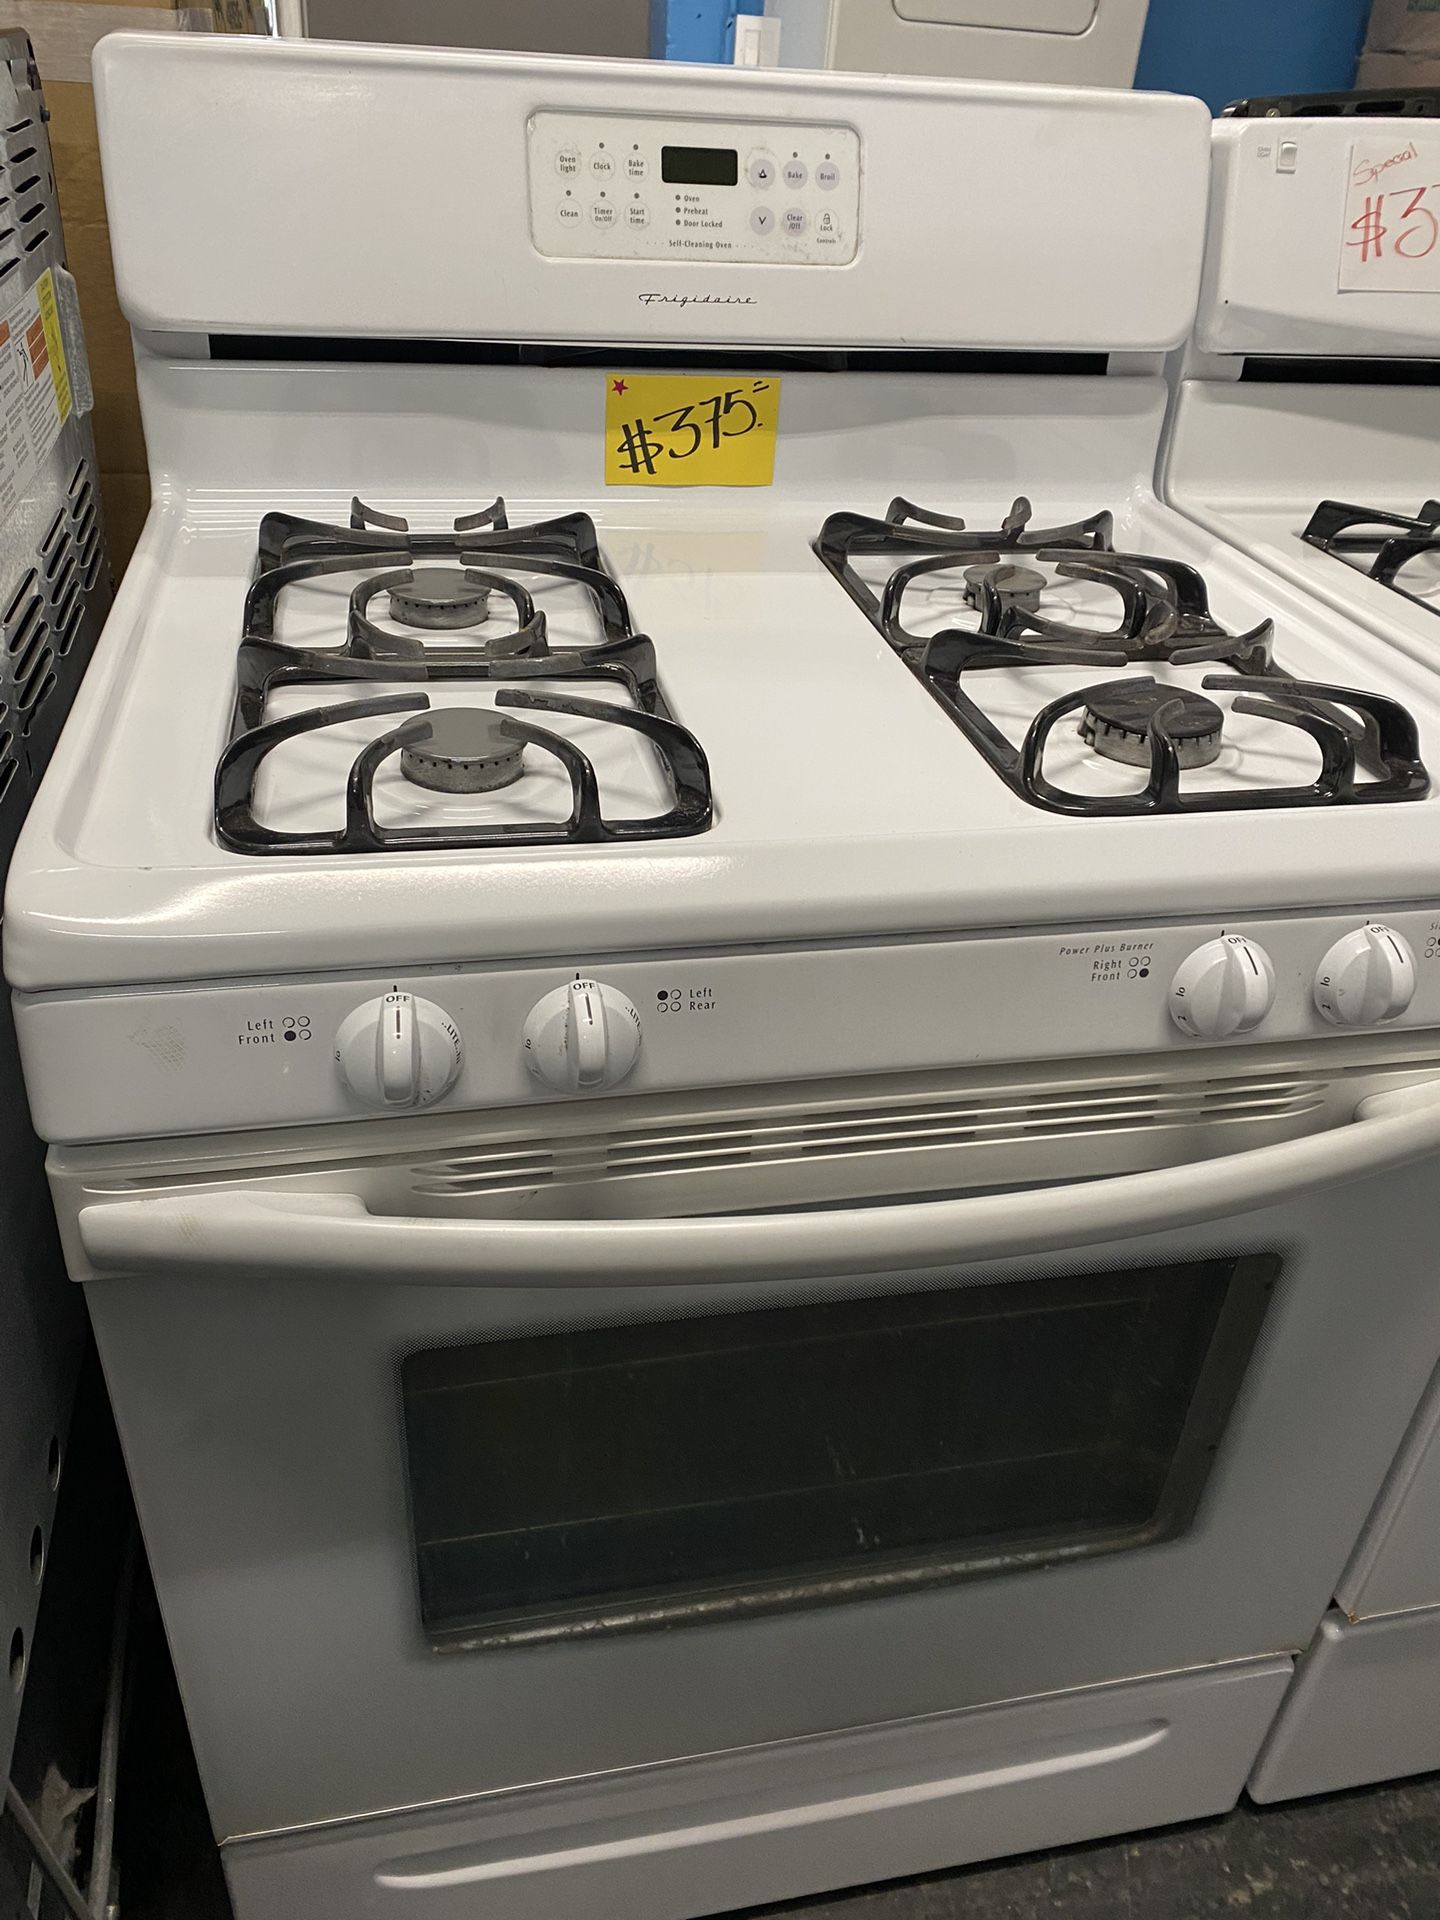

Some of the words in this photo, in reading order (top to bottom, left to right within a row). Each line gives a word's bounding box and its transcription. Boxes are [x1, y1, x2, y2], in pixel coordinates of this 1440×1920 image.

[559, 155, 577, 163] Oven
[628, 159, 644, 168] Bake
[560, 164, 576, 173] light
[593, 162, 611, 170] Clock
[628, 168, 644, 176] time
[787, 171, 803, 179] Bake
[820, 172, 836, 181] Broil
[683, 194, 700, 203] Oven
[560, 210, 579, 218] Clean
[594, 207, 613, 215] Timer
[629, 208, 645, 216] Start
[683, 207, 709, 215] Preheat
[630, 216, 645, 224] time
[786, 213, 803, 222] Clear
[683, 219, 700, 227] Door
[700, 220, 723, 228] Locked
[668, 240, 714, 249] Self-Cleaning
[715, 241, 732, 249] Oven
[638, 293, 758, 308] Frigidaire
[1059, 947, 1090, 956] Power
[1094, 944, 1115, 953] Plus
[1120, 943, 1154, 951] Burner
[1093, 960, 1122, 971] Right
[1091, 972, 1120, 982] Front
[573, 982, 596, 991] OFF
[689, 988, 712, 998] Left
[385, 995, 410, 1003] OFF
[689, 1001, 716, 1011] Rear
[247, 1019, 274, 1031] Left
[238, 1033, 276, 1045] Front
